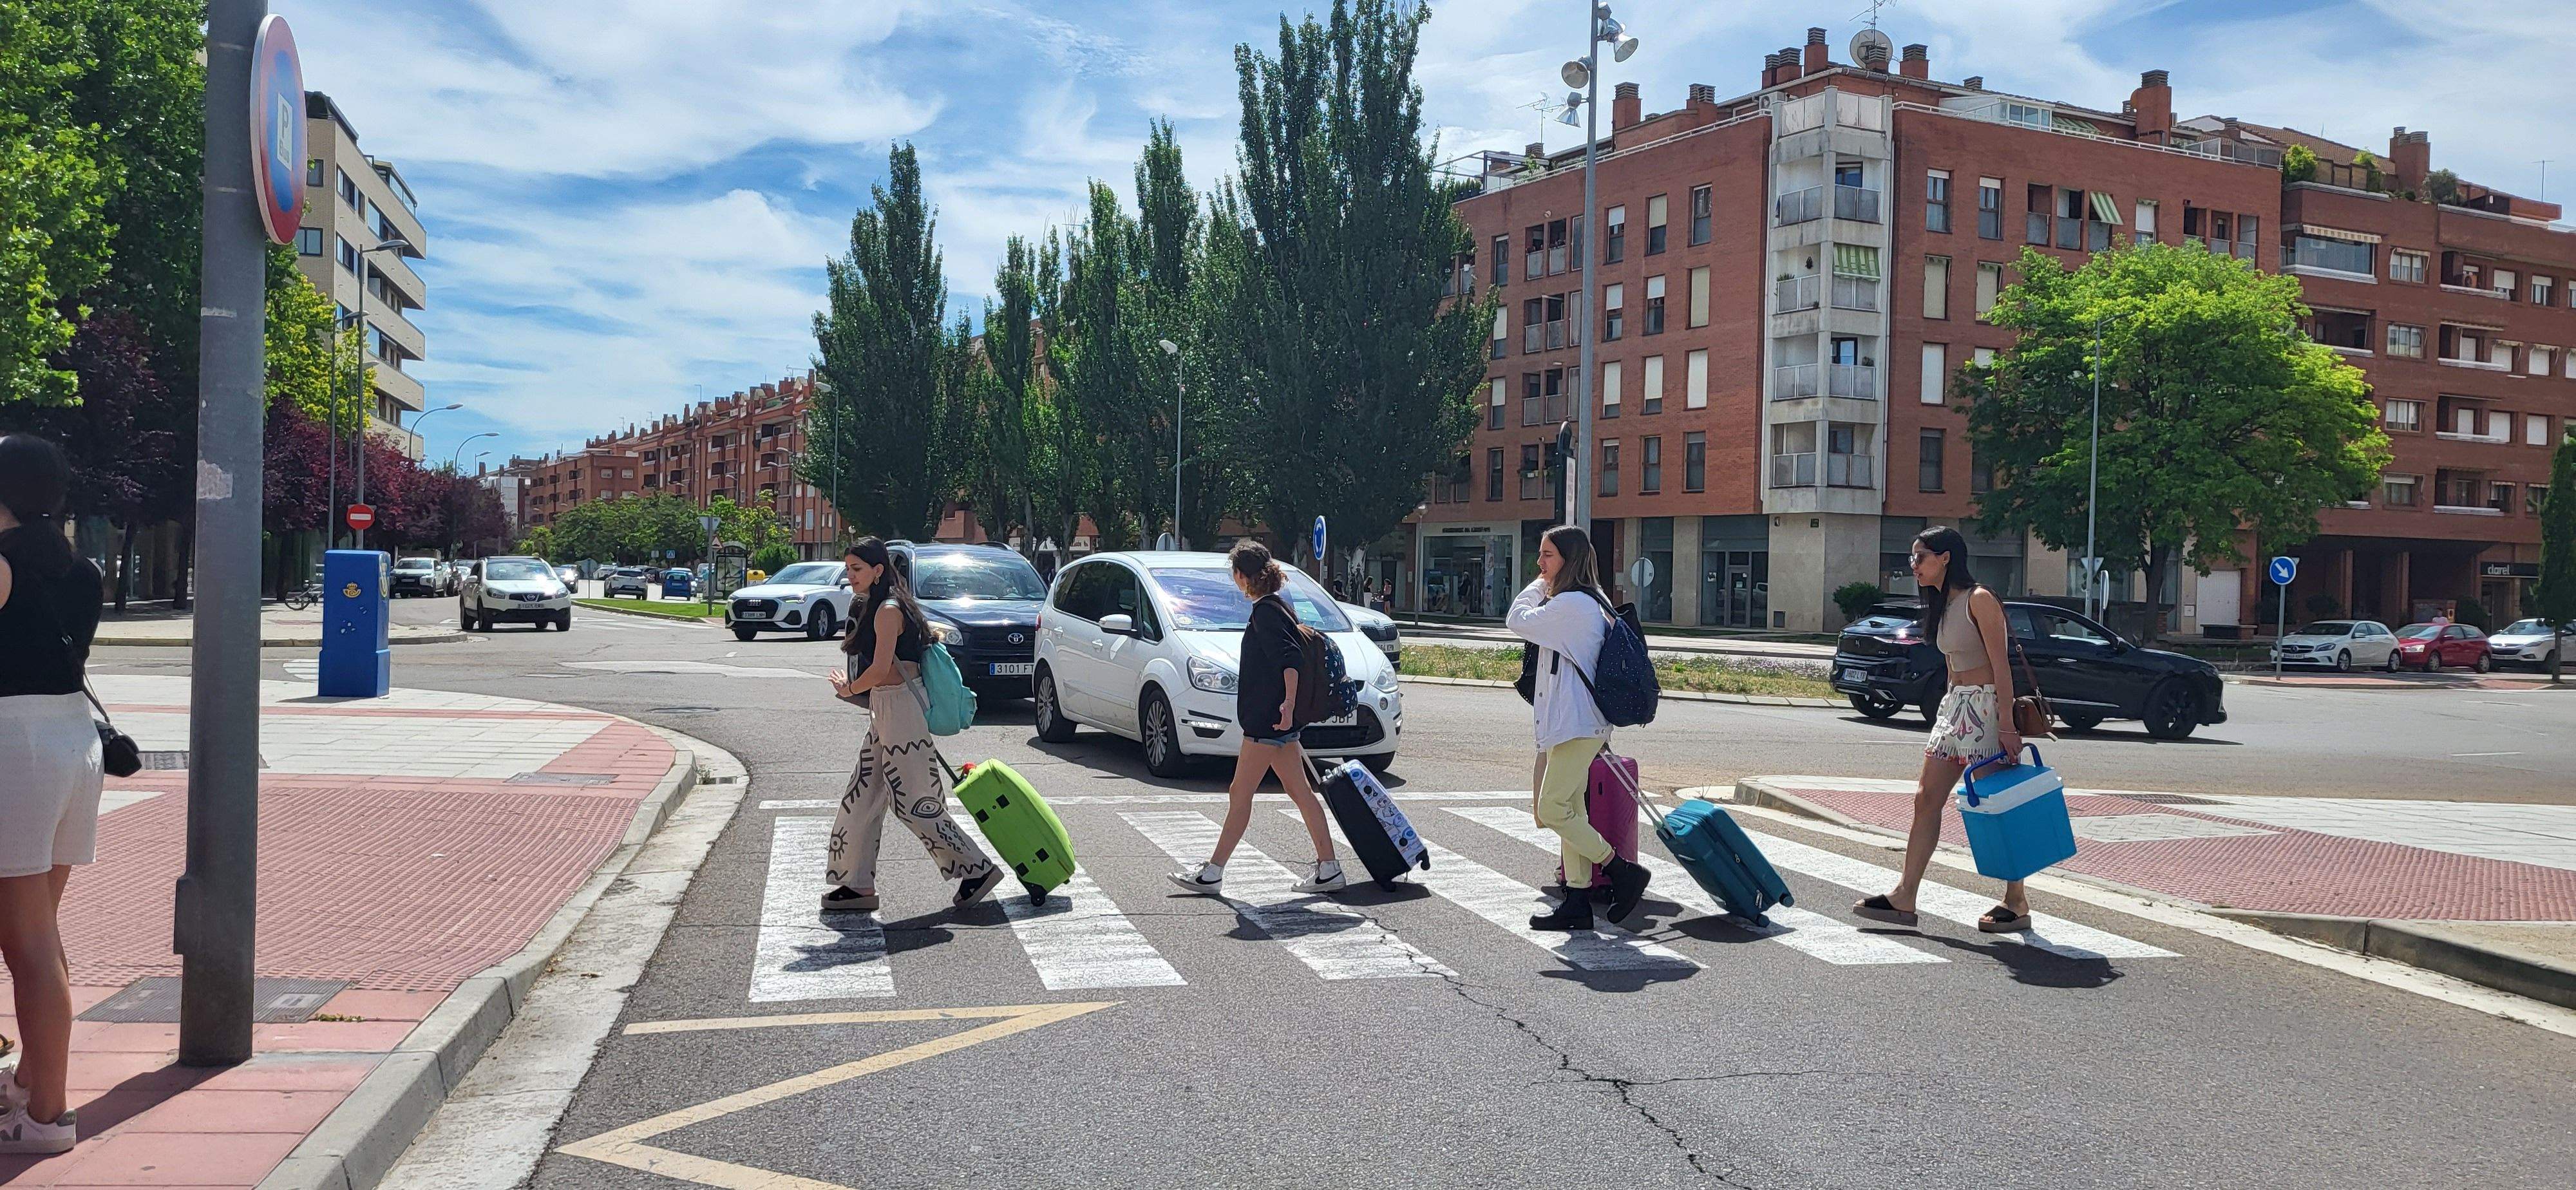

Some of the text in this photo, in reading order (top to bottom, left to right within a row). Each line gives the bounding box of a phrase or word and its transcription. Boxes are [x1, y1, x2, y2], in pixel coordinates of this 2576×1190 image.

[282, 103, 289, 139] P
[997, 664, 1034, 674] 3101 FT
